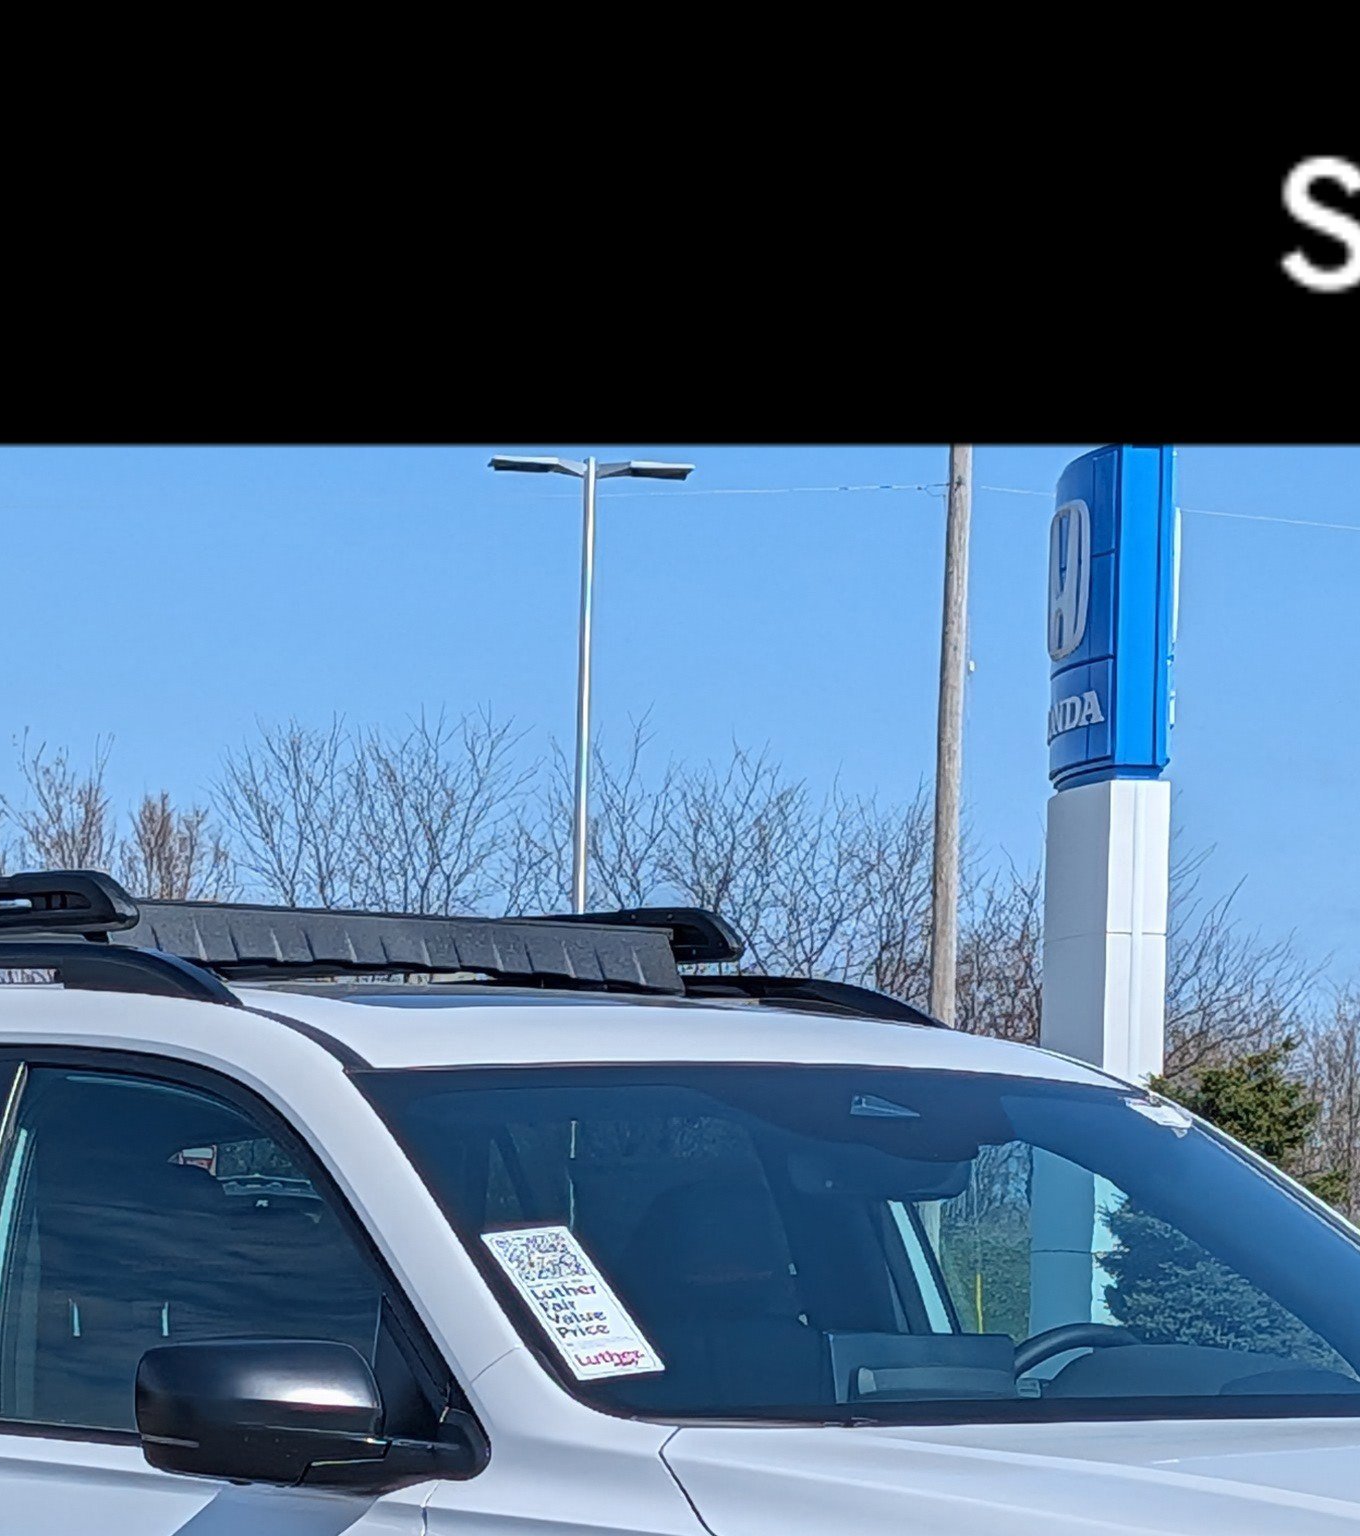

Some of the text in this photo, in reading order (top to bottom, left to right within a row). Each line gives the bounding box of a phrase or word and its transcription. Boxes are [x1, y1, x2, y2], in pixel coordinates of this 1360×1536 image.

[530, 1284, 597, 1300] Luther
[539, 1299, 576, 1313] Fair
[547, 1311, 607, 1325] Value
[555, 1324, 610, 1338] Price
